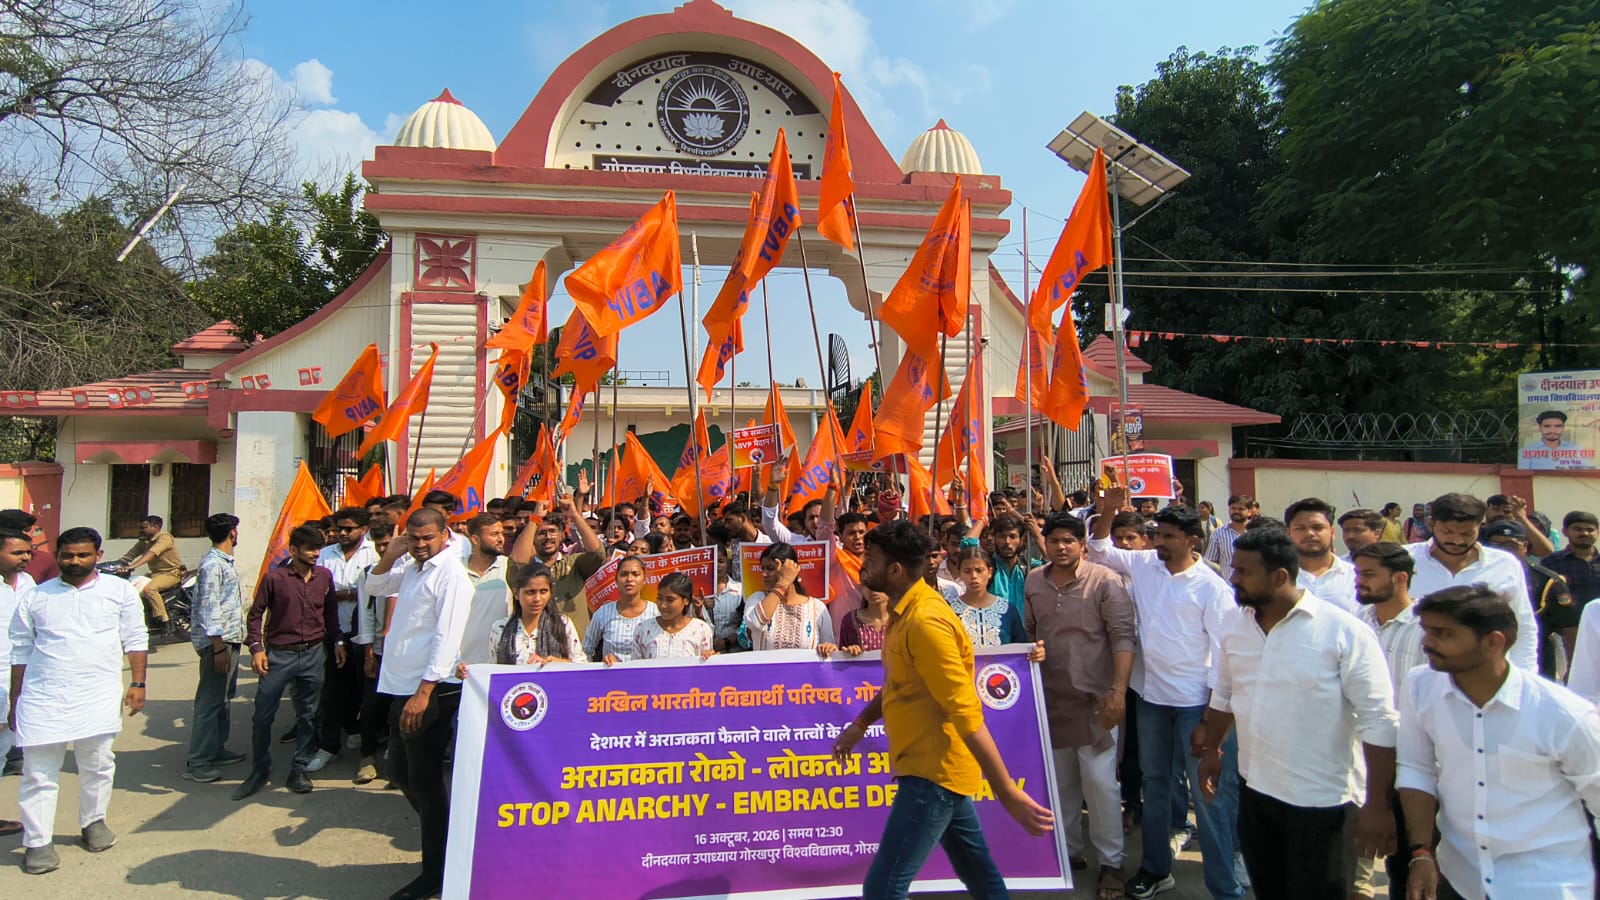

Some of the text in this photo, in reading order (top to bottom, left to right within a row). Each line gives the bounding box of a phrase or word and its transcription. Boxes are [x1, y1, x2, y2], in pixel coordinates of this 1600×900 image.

[611, 54, 690, 88] दीनदयाल
[728, 59, 796, 99] उपाध्याय
[601, 157, 666, 174] गोरखपर
[1540, 379, 1586, 391] दीनदयाल
[1125, 423, 1142, 433] ABVP
[657, 556, 669, 567] के
[670, 553, 701, 566] सम्मान
[702, 549, 712, 560] में
[643, 573, 668, 585] ABV
[699, 565, 709, 575] में
[588, 691, 648, 712] अखिल
[651, 688, 716, 709] भारतीय
[719, 684, 784, 707] विद्यार्थी
[787, 684, 842, 704] परिषद
[590, 733, 632, 750] देशभर
[634, 731, 646, 747] में
[649, 732, 715, 746] अराजकता
[718, 726, 760, 743] फैलाने
[763, 725, 791, 741] वाले
[793, 723, 824, 740] तत्वों
[826, 723, 841, 738] के
[561, 761, 684, 789] अराजकता
[689, 751, 746, 782] रोको
[766, 748, 862, 780] लोकतत्र
[498, 801, 570, 827] STOP
[576, 794, 709, 823] ANARCHY
[734, 786, 859, 814] EMBRACE
[695, 834, 706, 844] 16
[710, 832, 750, 847] अक्टूबर,
[753, 830, 779, 841] 2026
[788, 828, 813, 839] समय
[816, 827, 843, 837] 12:30
[642, 839, 880, 868] दीनदयाल उपाध्याय गोरखपुर विश्वविद्यालय, गोरख
